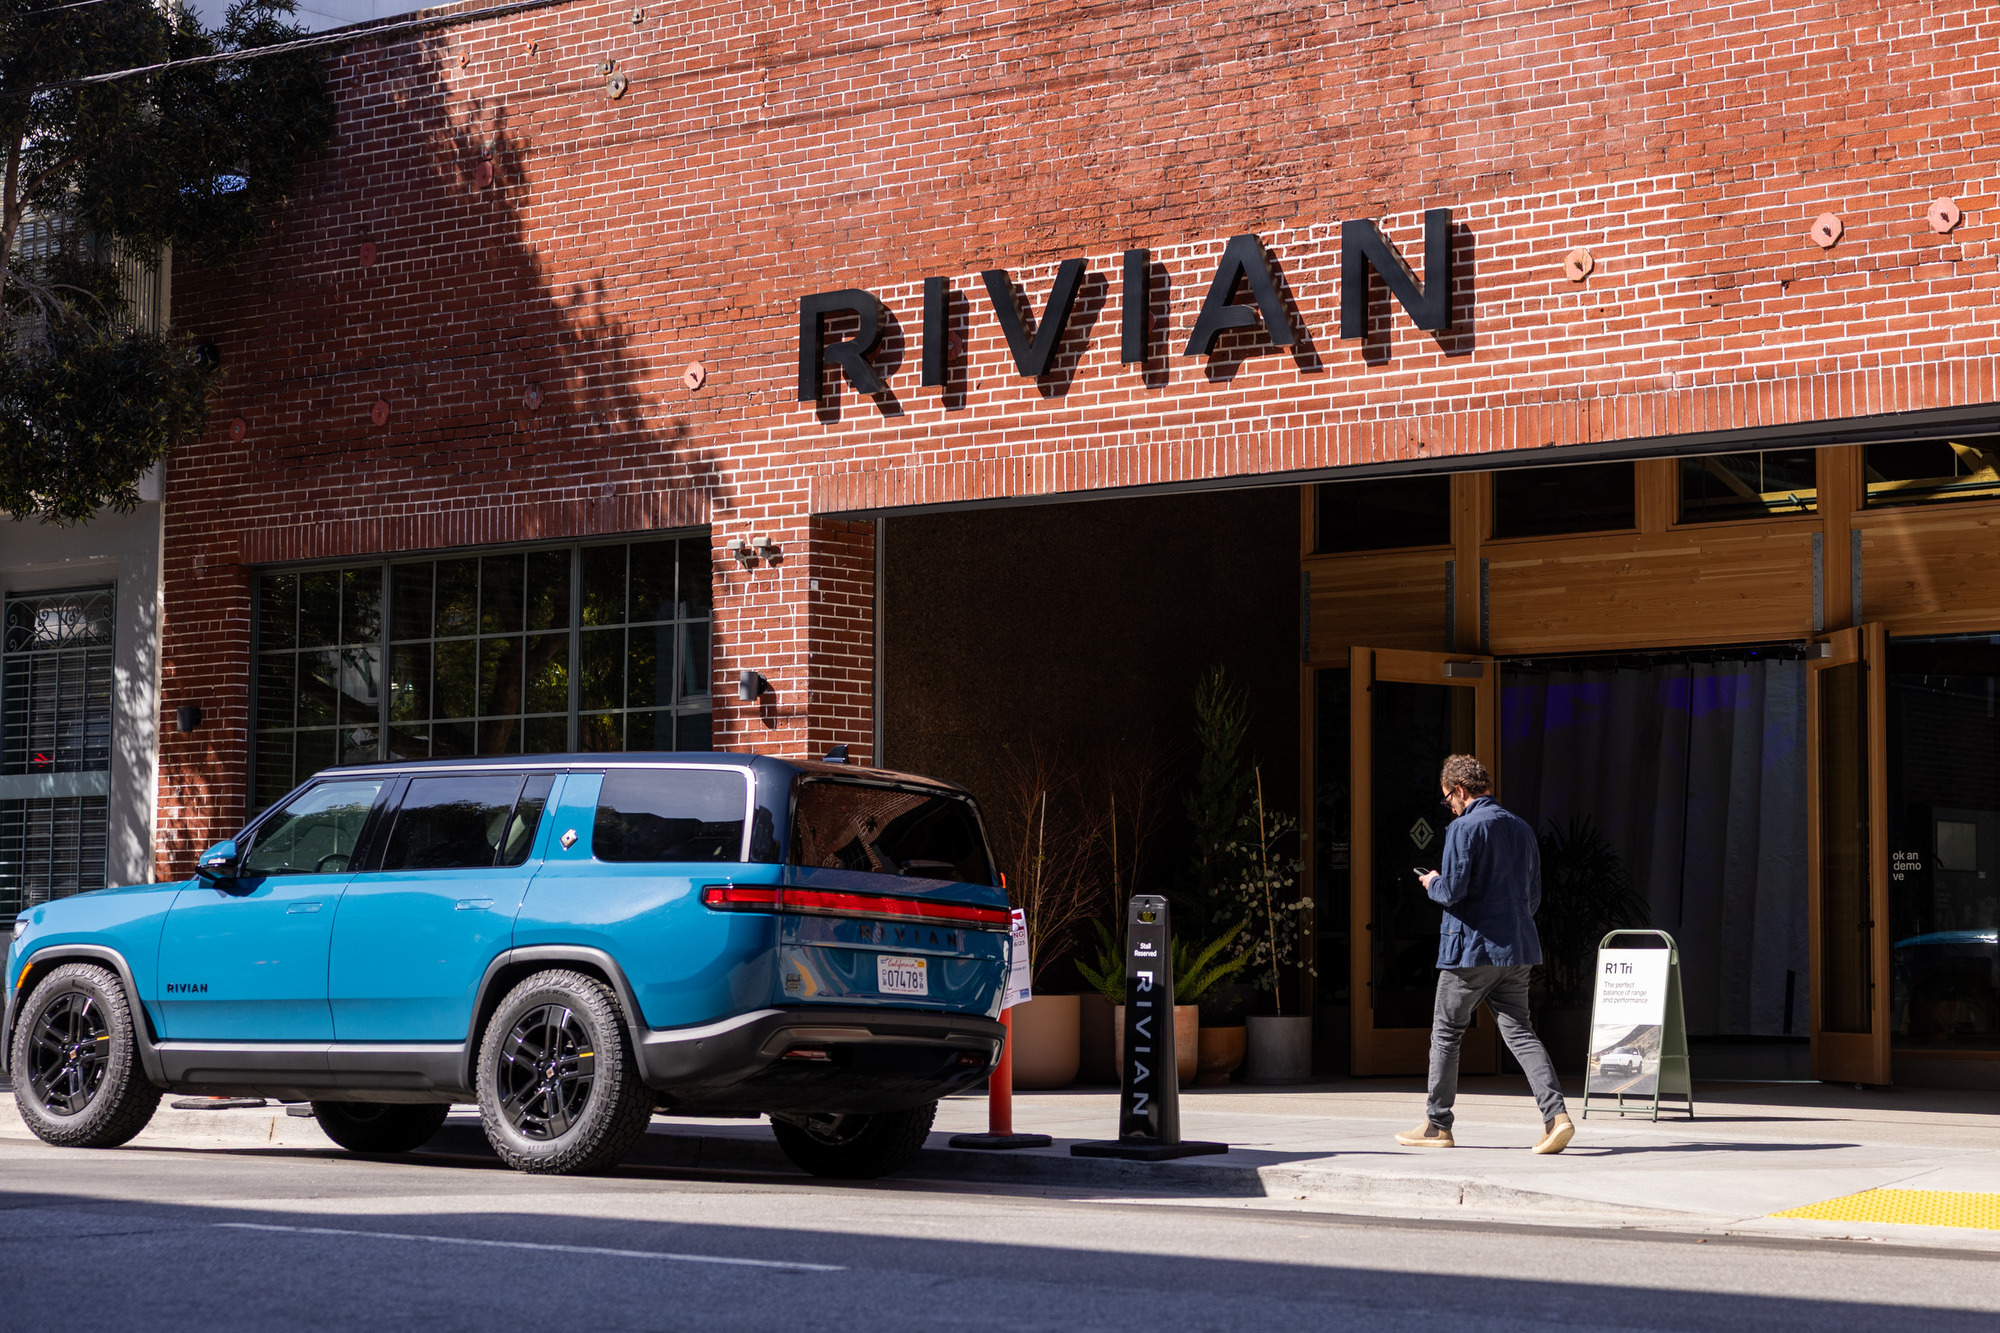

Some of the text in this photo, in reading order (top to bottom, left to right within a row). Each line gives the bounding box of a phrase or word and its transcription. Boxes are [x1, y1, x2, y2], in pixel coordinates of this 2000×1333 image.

[797, 207, 1454, 402] RIVIAN
[1893, 861, 1922, 871] demo
[859, 925, 957, 946] RIVIAN
[1139, 942, 1152, 950] Stall
[1134, 949, 1158, 957] Reserved
[887, 957, 916, 970] California
[1605, 962, 1633, 974] R1 Tri
[887, 970, 919, 989] 07478
[166, 983, 208, 993] RIVIAN
[1615, 981, 1635, 990] perfect
[1625, 988, 1631, 996] of
[1631, 990, 1647, 998] range
[1614, 997, 1648, 1005] performance
[1132, 970, 1154, 1116] RIVIAN
